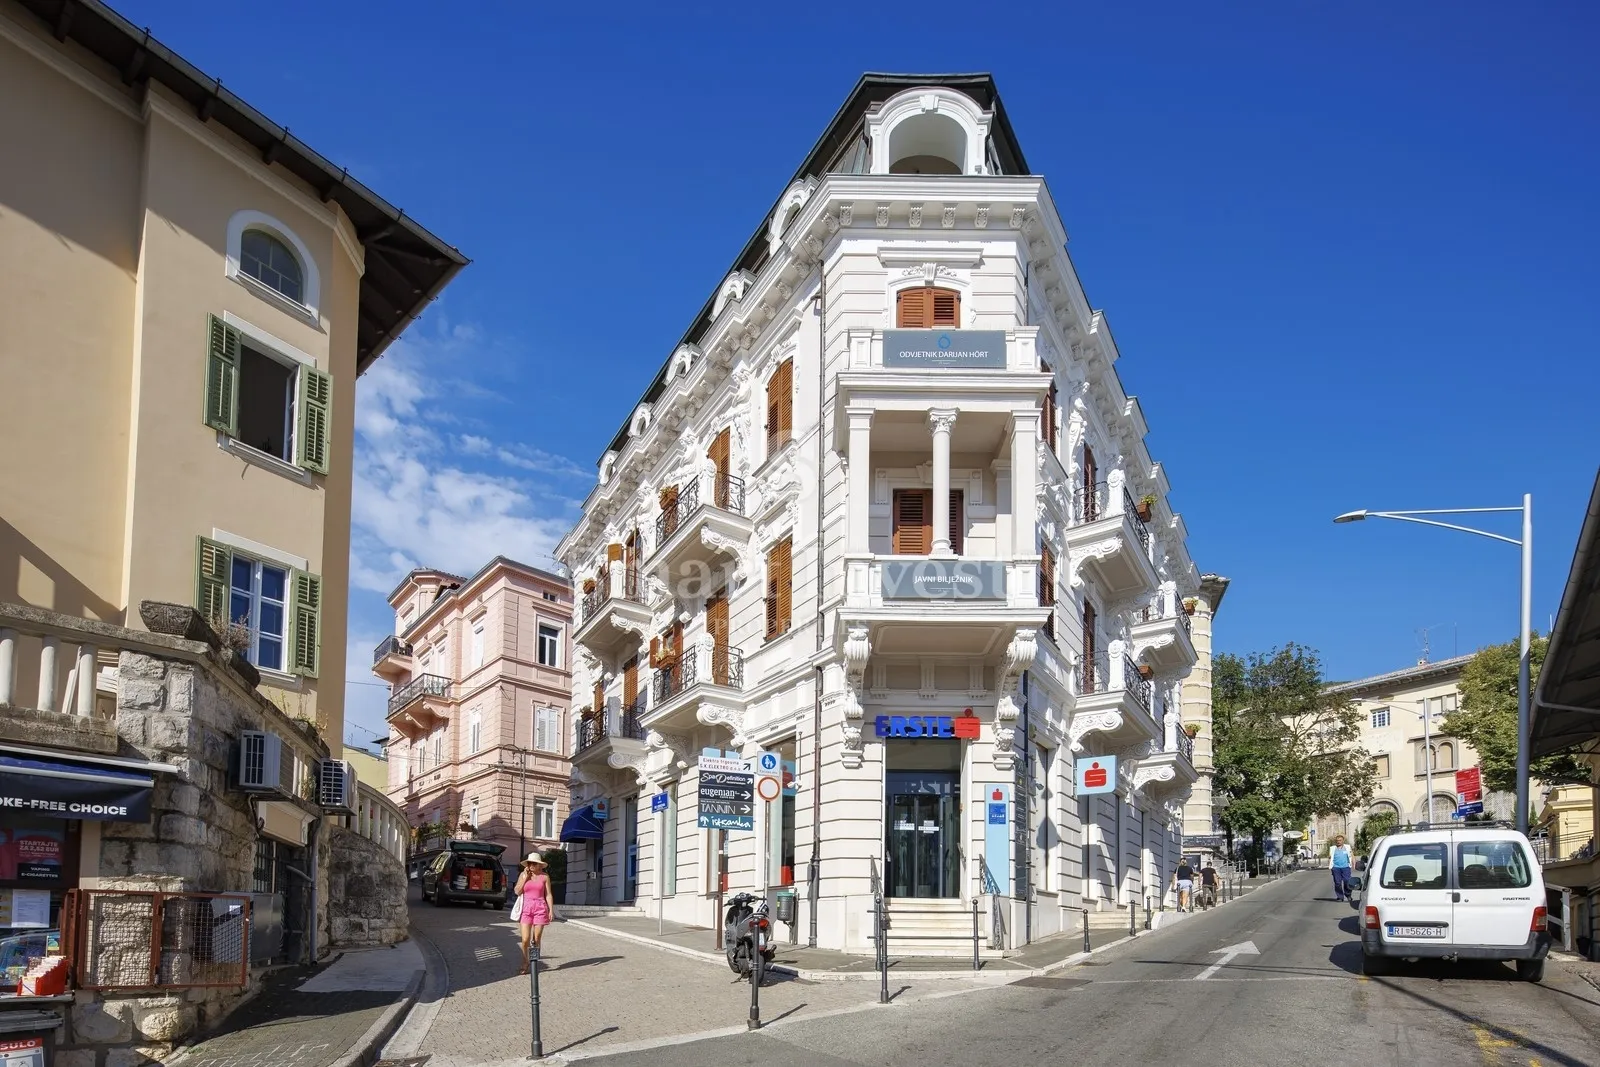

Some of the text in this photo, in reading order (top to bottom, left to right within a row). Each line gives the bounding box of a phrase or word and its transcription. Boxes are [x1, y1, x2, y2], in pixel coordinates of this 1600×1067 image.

[914, 574, 973, 584] JAVNI BILJEŽNIK
[876, 715, 952, 738] ERSTE
[69, 803, 127, 816] CHOICE
[701, 803, 736, 814] TANNIN
[0, 1040, 36, 1050] SULO
